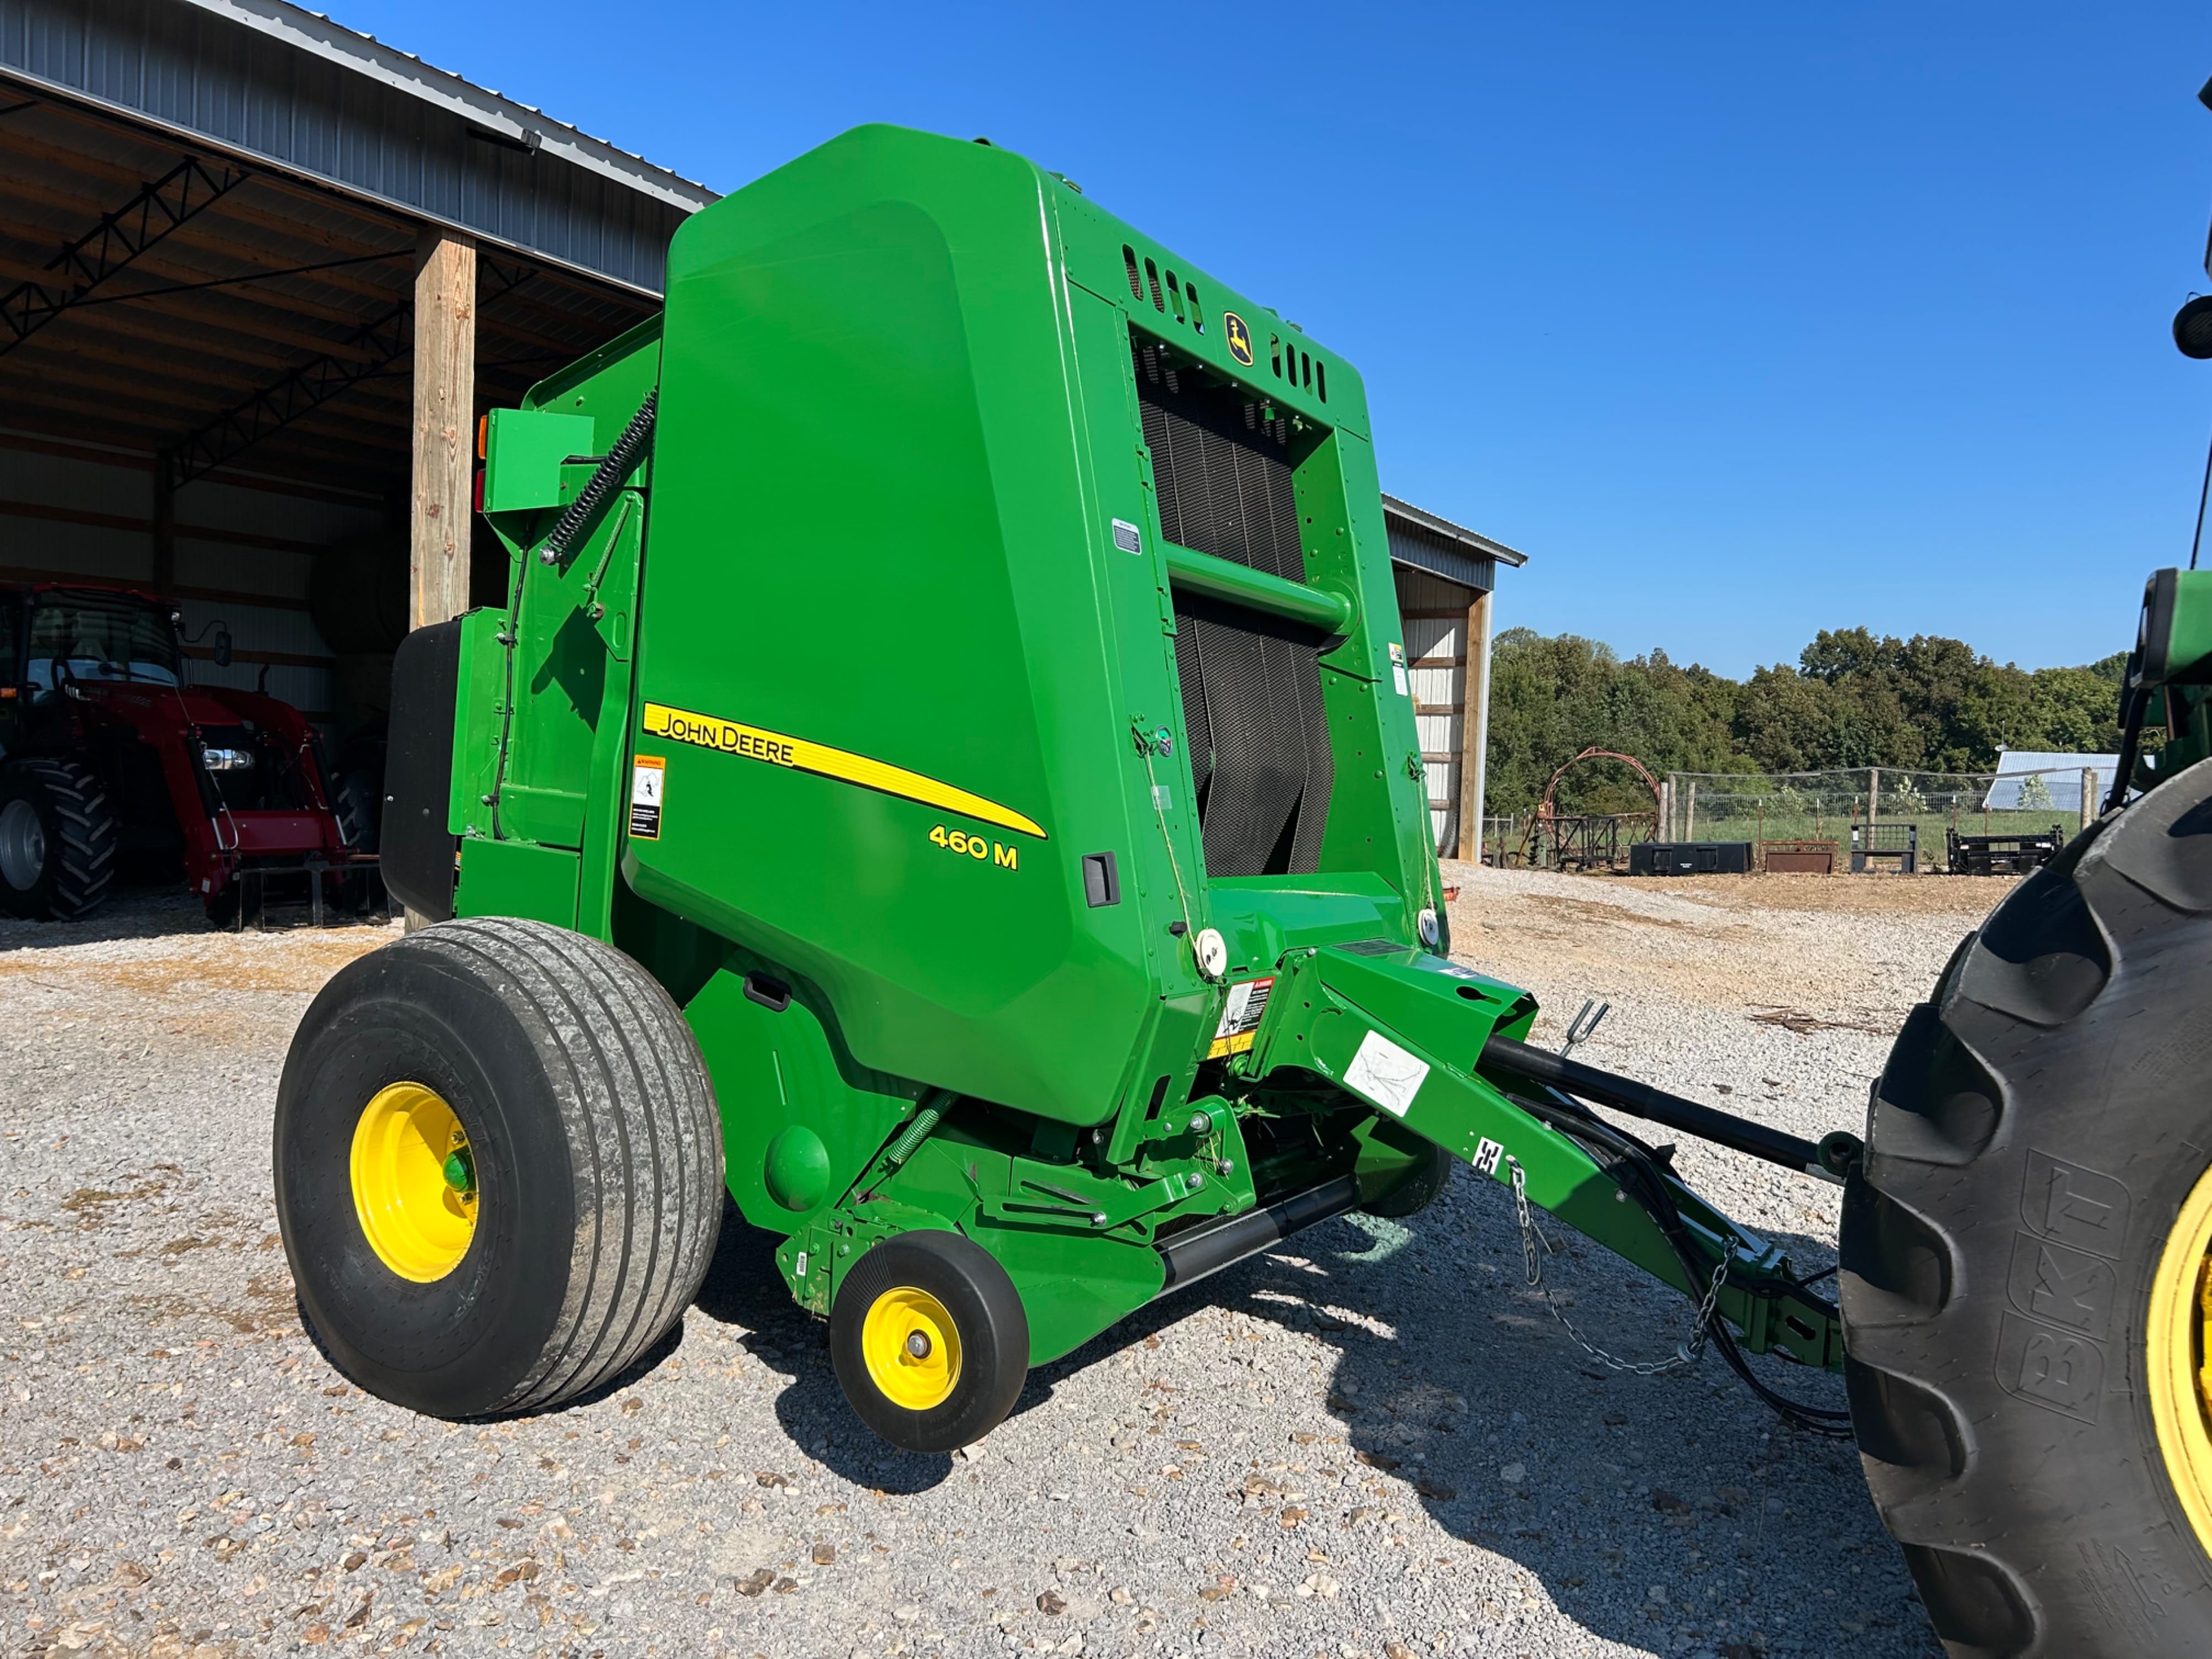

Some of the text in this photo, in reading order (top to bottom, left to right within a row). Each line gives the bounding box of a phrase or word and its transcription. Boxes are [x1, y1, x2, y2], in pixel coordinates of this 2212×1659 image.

[660, 713, 794, 763] JOHN DEERE
[929, 825, 1018, 871] 460 M
[2013, 1164, 2115, 1413] BKT
